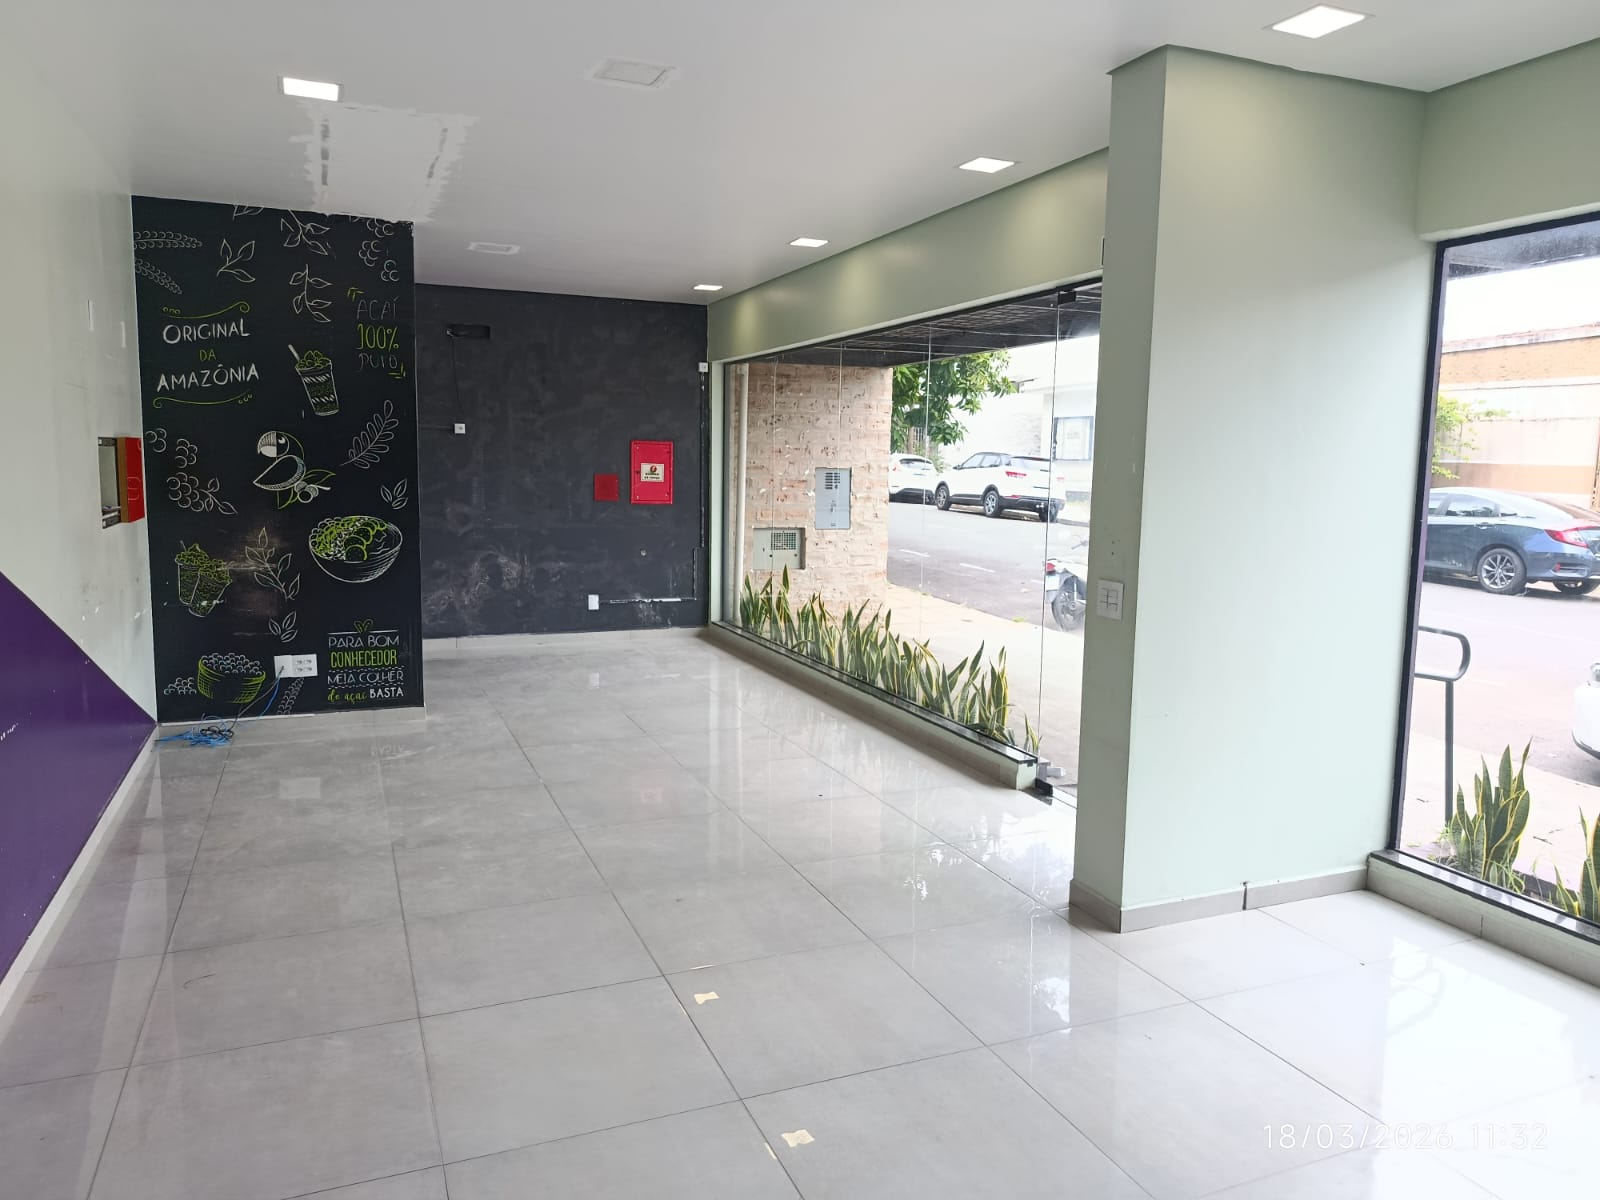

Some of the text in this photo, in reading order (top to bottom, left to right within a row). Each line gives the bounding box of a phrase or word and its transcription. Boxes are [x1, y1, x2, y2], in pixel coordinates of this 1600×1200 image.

[163, 318, 251, 344] ORIGINAL
[355, 323, 400, 352] 100%
[199, 349, 217, 361] DA
[157, 363, 260, 393] AMAZÔNIA
[328, 635, 399, 648] PARA BOM
[331, 650, 397, 668] CONHECEDOR
[327, 671, 404, 685] MEIA COLHER
[369, 686, 404, 699] BASTA
